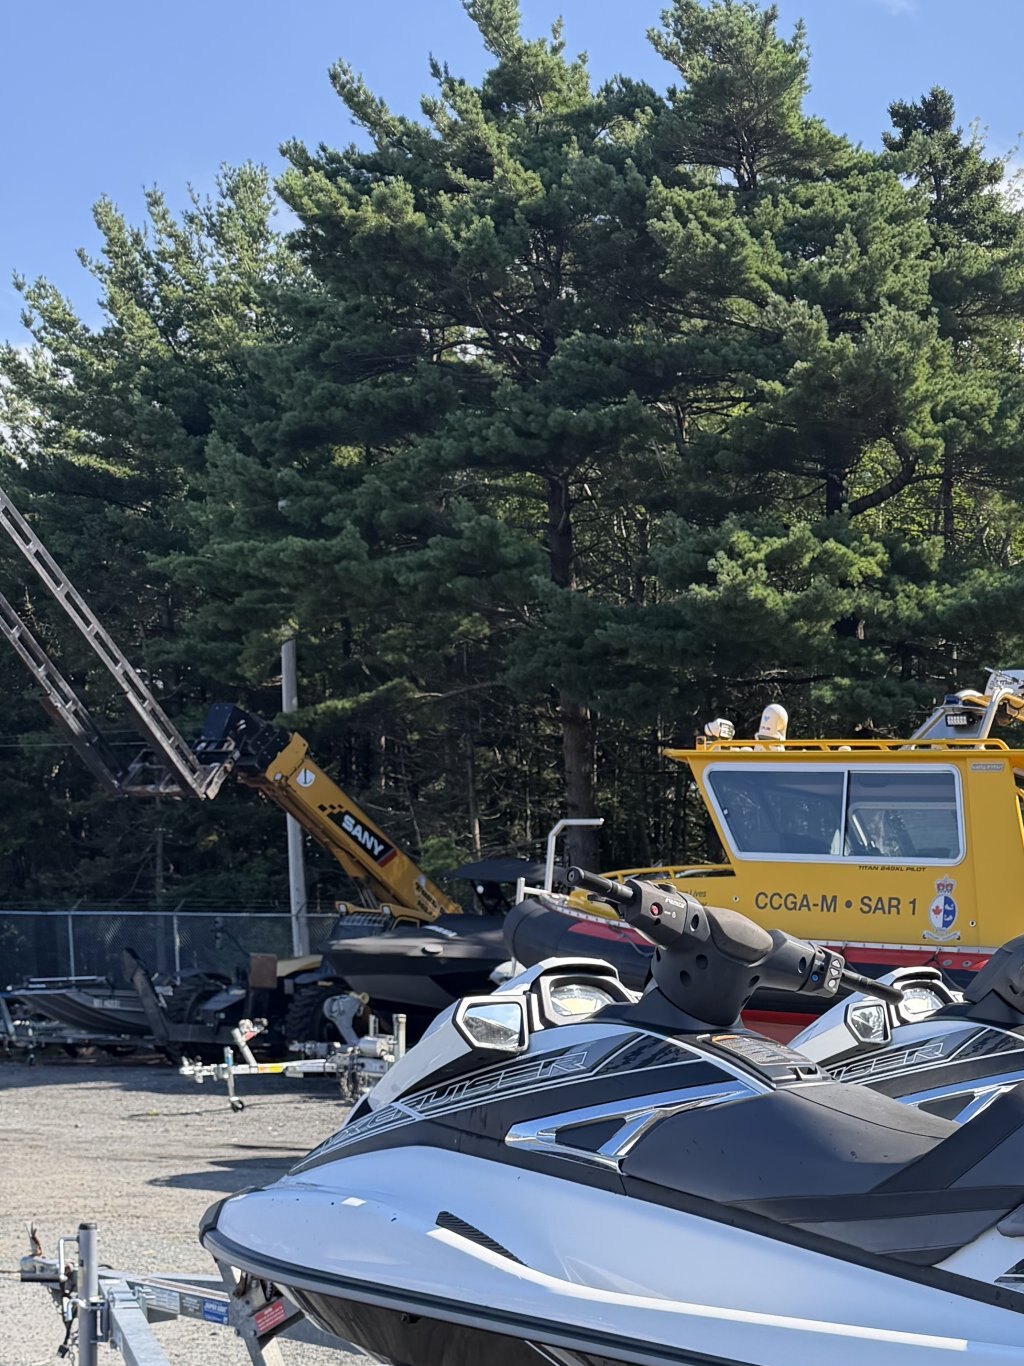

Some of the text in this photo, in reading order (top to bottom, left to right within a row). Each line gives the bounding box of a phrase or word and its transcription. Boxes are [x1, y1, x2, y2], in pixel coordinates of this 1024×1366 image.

[341, 814, 384, 856] SANY
[755, 891, 918, 916] CCGA-M SAR 1
